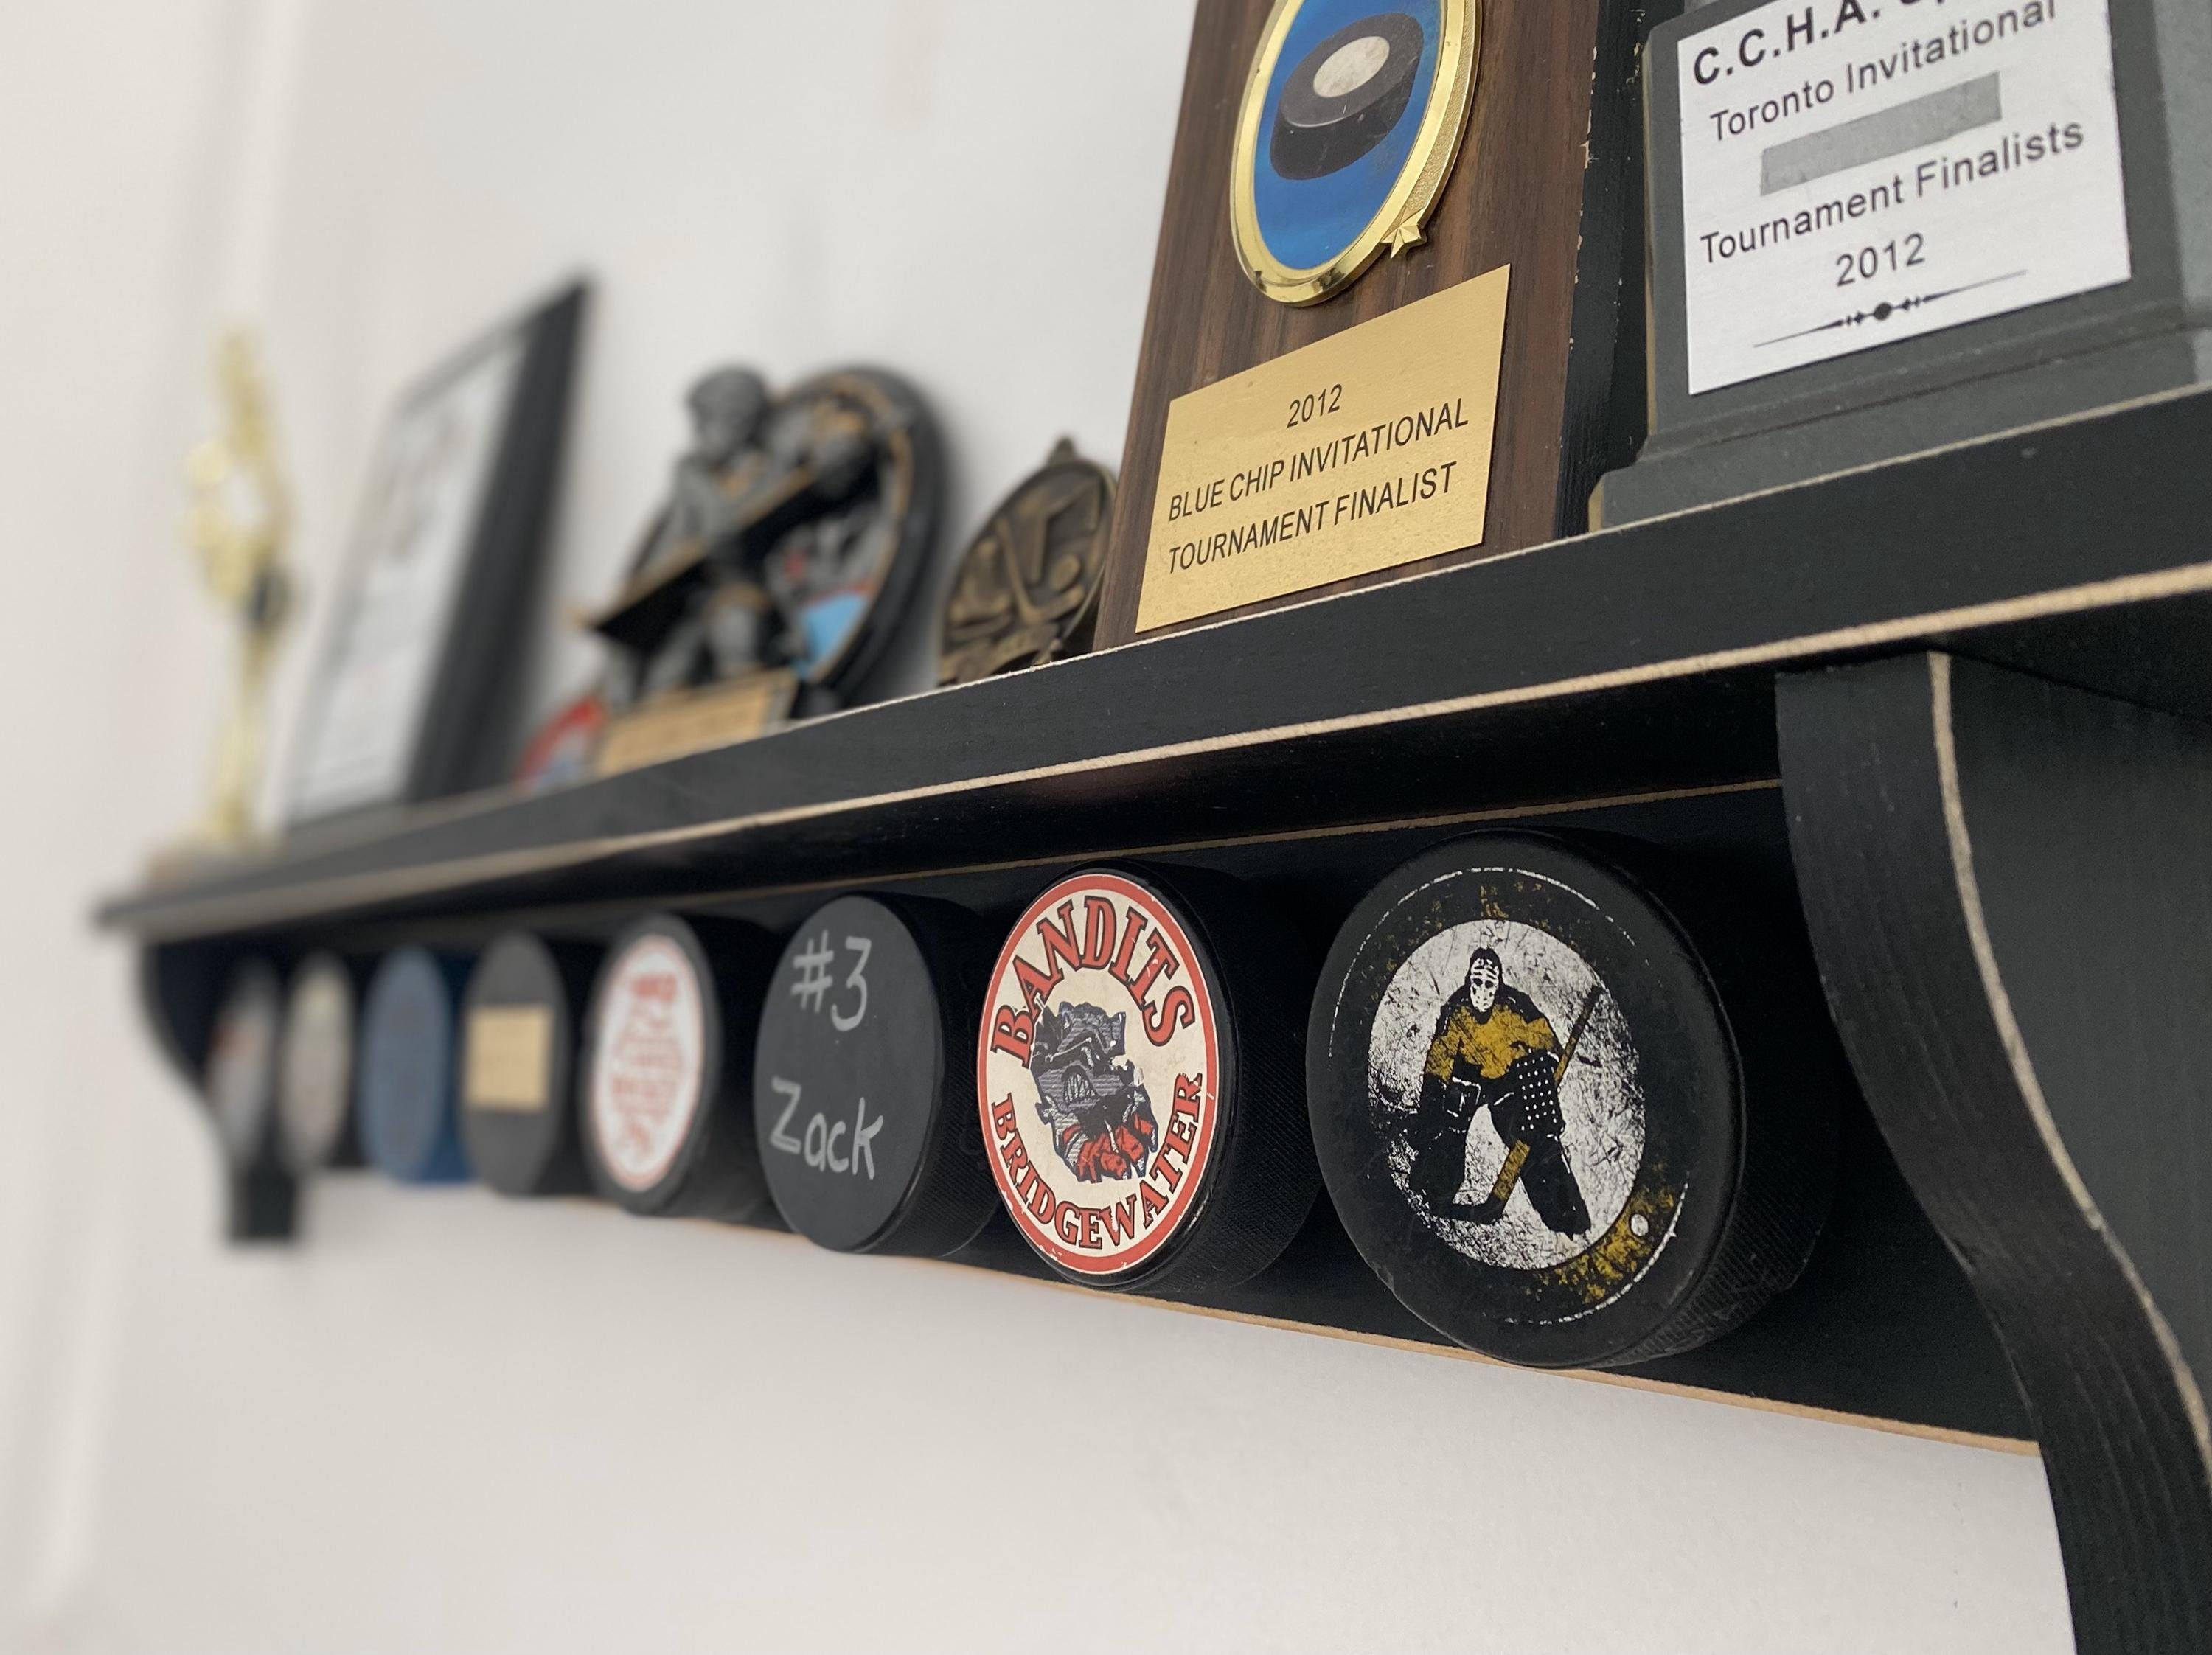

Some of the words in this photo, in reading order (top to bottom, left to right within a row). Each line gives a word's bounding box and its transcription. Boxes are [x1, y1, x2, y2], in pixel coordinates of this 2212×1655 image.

[1710, 79, 1834, 141] Toronto
[1847, 0, 2056, 93] Invitational
[1700, 176, 1905, 264] Tournament
[1916, 120, 2084, 198] Finalists
[1836, 232, 1926, 287] 2012
[1169, 479, 1225, 521] BLUE
[1230, 459, 1284, 501] CHIP
[1290, 398, 1469, 481] INVITATIONAL
[1287, 383, 1343, 428] 2012
[1169, 500, 1329, 574] TOURNAMENT
[1334, 461, 1457, 526] FINALIST
[790, 929, 872, 1032] #3
[990, 895, 1196, 1069] BANDITS
[769, 1076, 884, 1180] Zack
[991, 1072, 1203, 1250] BRIDGEWATER
